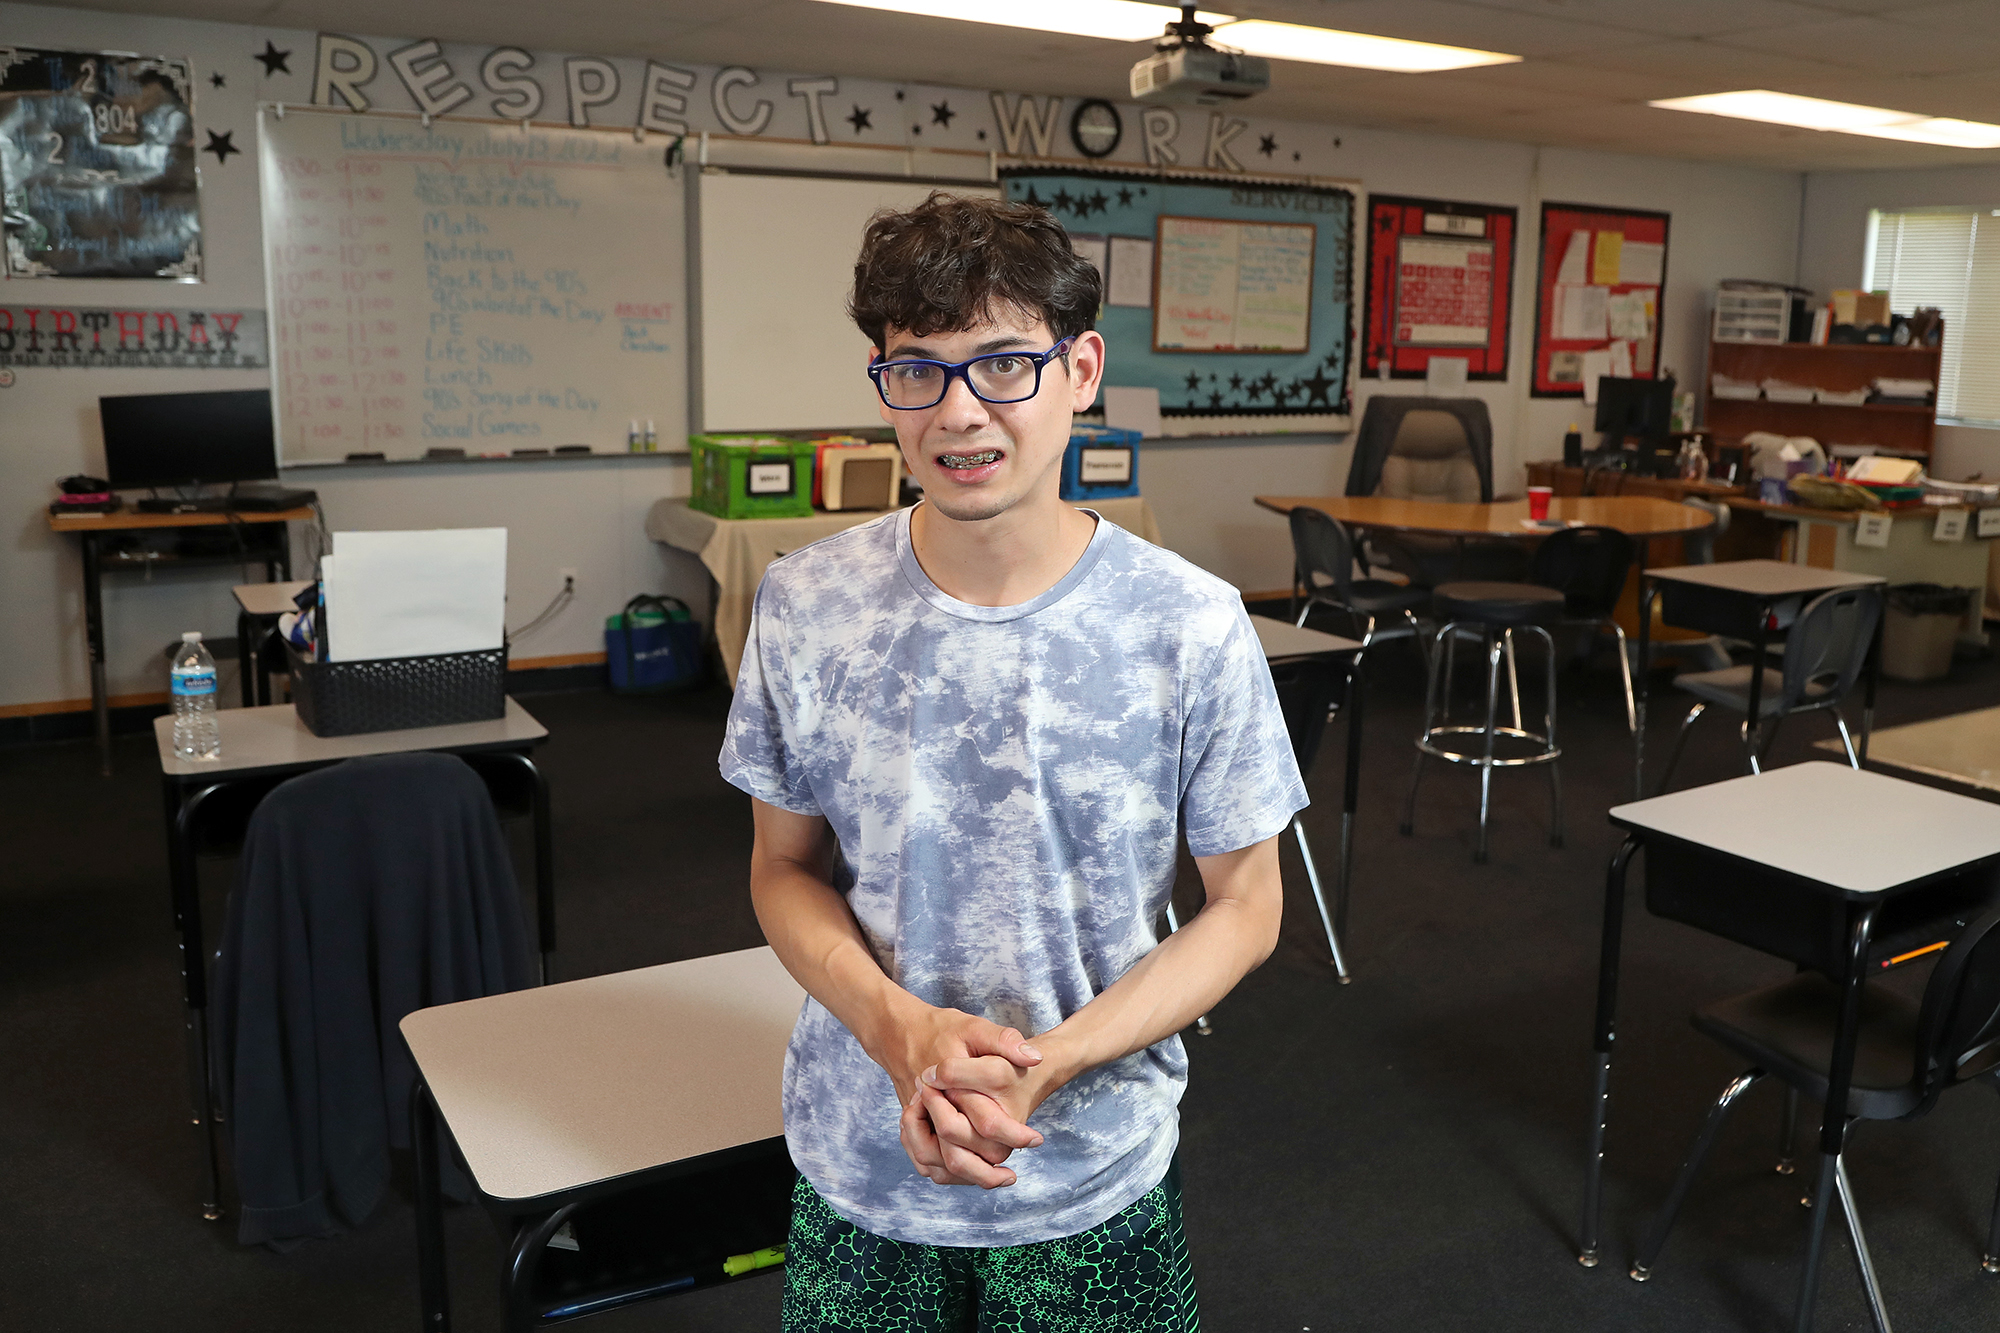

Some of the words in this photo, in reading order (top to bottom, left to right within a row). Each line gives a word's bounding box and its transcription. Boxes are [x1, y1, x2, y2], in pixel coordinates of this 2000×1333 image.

[81, 60, 97, 93] 2
[309, 32, 839, 145] RESPECT
[95, 103, 138, 134] 804
[988, 91, 1247, 174] WORK
[48, 131, 65, 165] 2
[1230, 189, 1344, 214] SERVICES
[423, 211, 489, 237] Math
[429, 312, 465, 337] PE
[425, 336, 468, 364] Life
[424, 366, 492, 387] Lunch
